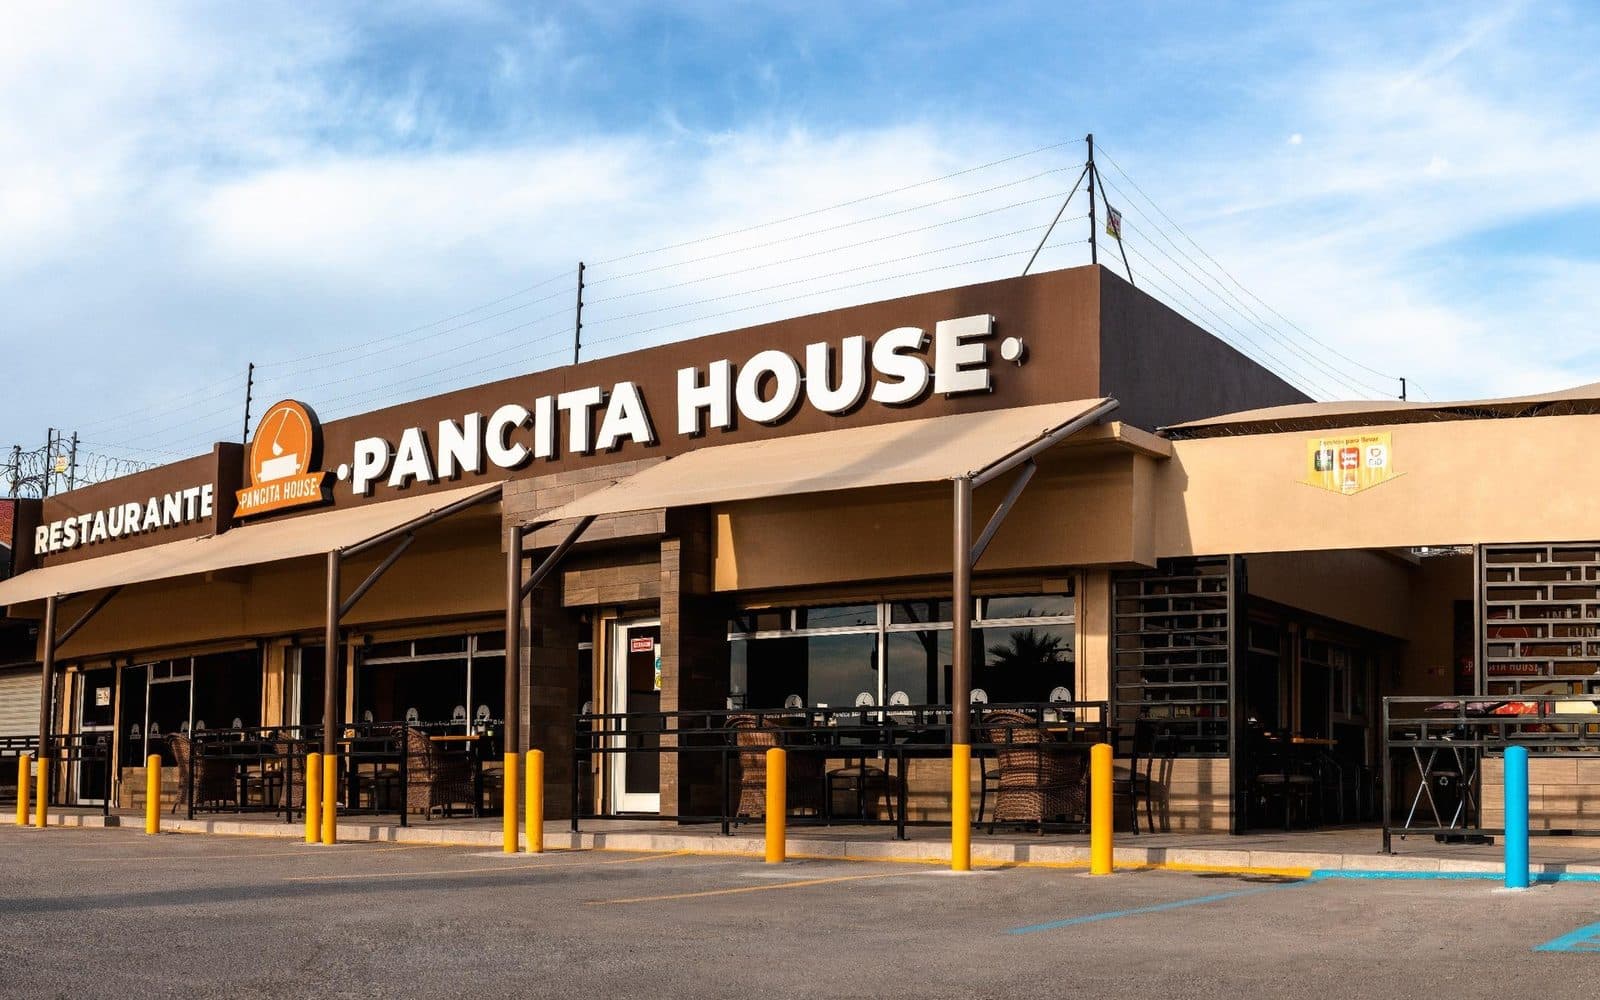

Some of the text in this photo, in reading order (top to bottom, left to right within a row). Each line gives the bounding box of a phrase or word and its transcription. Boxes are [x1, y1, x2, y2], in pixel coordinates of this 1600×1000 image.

[352, 313, 996, 494] PANCITA HOUSE
[34, 483, 213, 555] RESTAURANTE
[241, 477, 317, 509] PANCITA HOUSE
